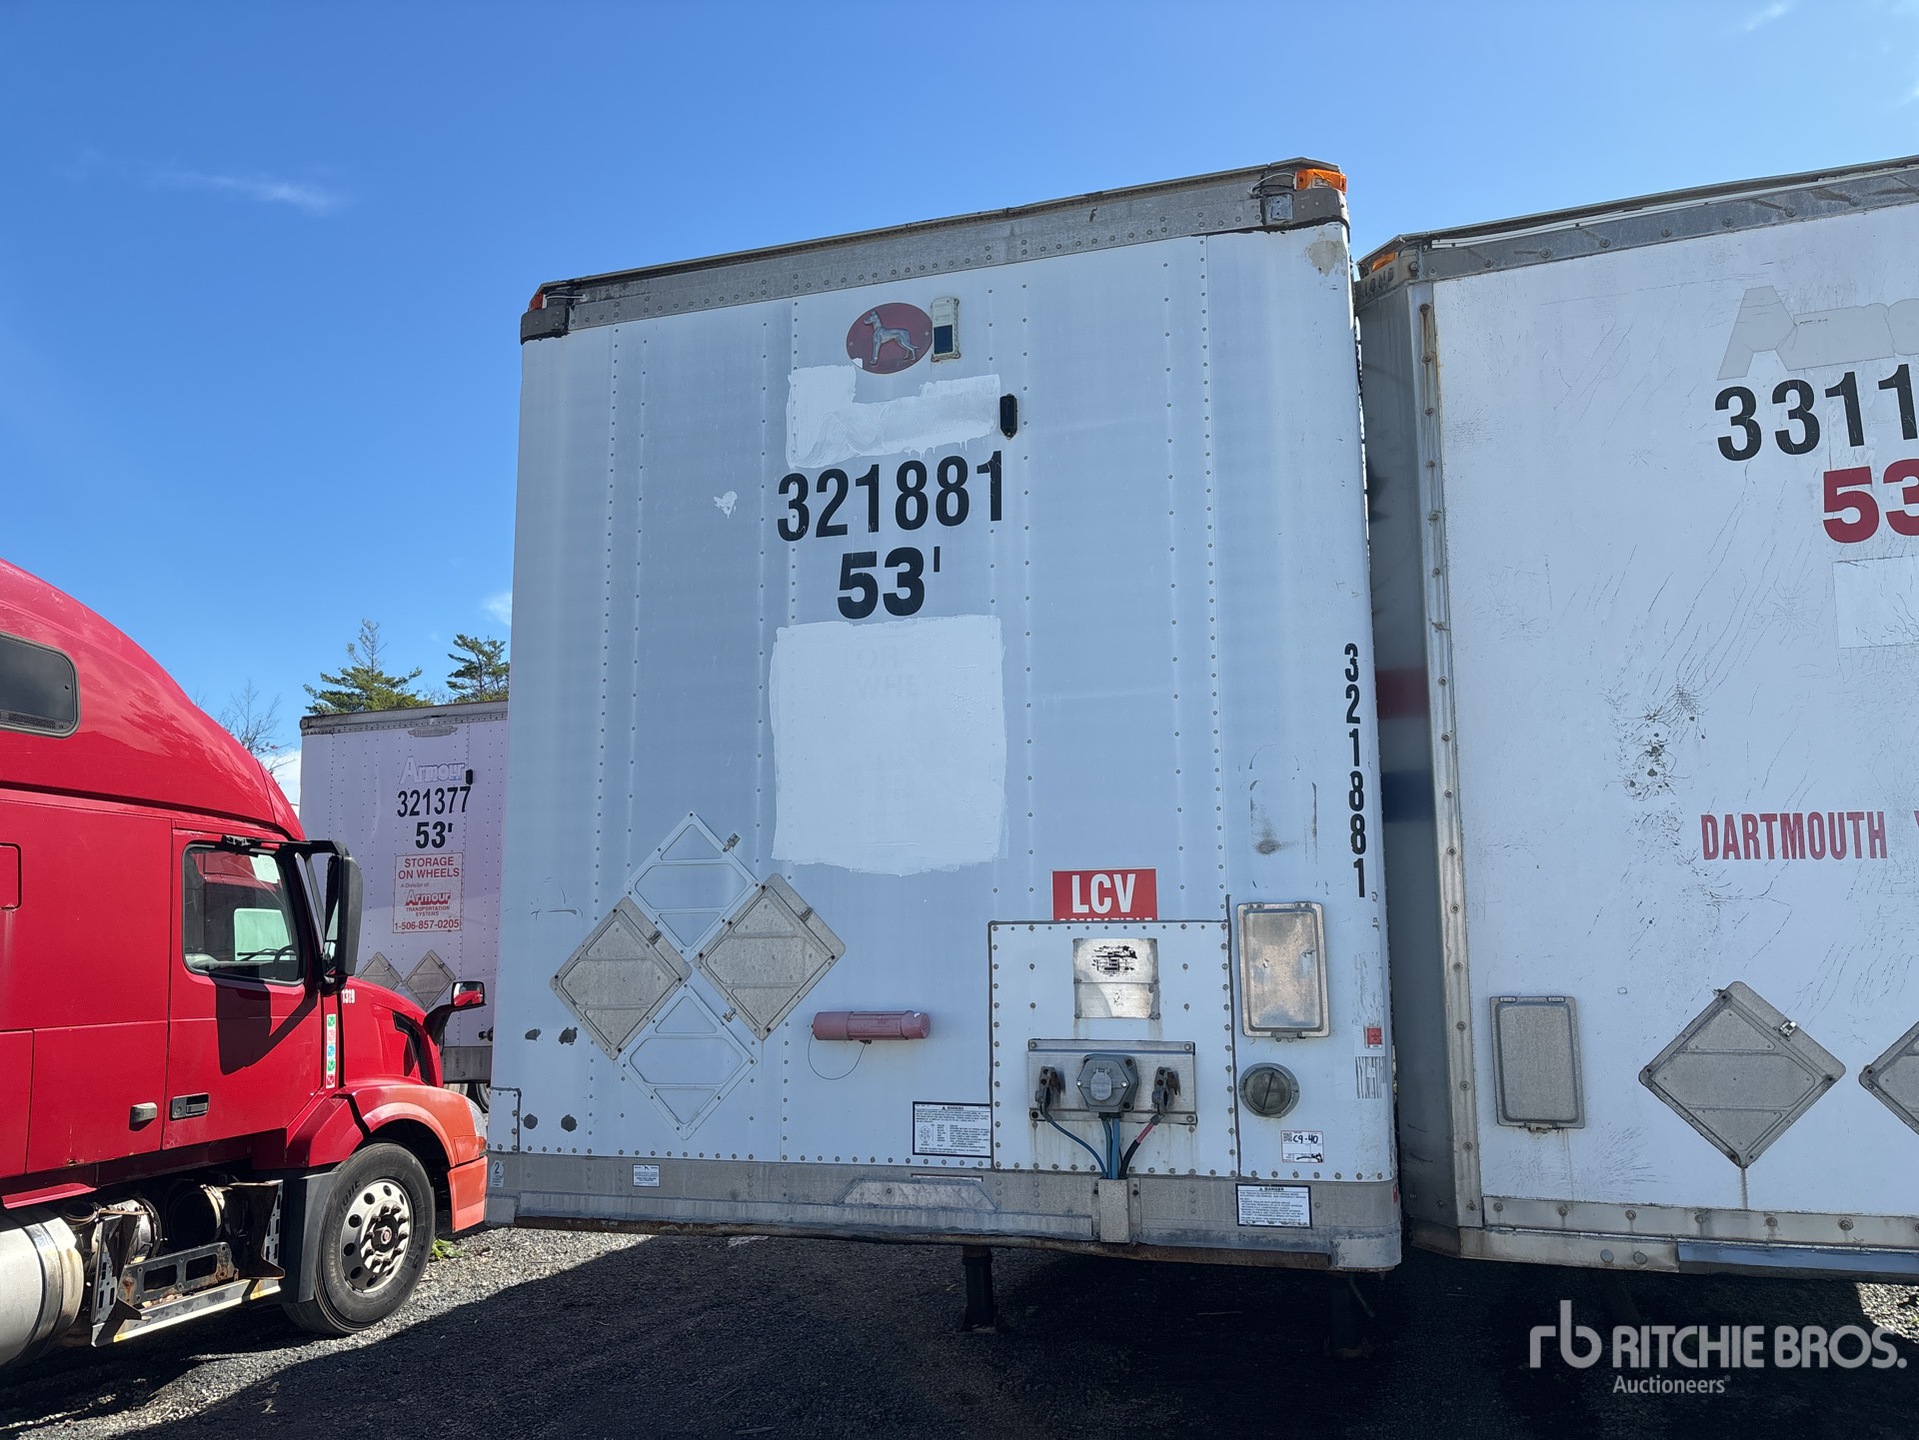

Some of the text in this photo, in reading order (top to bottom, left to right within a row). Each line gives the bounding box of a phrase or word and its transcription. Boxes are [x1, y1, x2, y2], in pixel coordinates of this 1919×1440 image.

[1715, 363, 1918, 461] 3311
[777, 450, 1002, 542] 321881
[1823, 458, 1919, 543] 53
[837, 546, 941, 619] 53'
[1344, 643, 1367, 897] 321881
[397, 786, 471, 817] 321377
[415, 821, 453, 849] 53'
[1701, 810, 1888, 860] DARTMOUTH
[398, 867, 460, 879] ON WHEELS
[404, 856, 455, 868] STORAGE
[405, 889, 451, 906] Armour
[1071, 873, 1136, 914] LCV
[395, 919, 460, 931] 1-506-857-0205
[494, 1162, 500, 1174] 2
